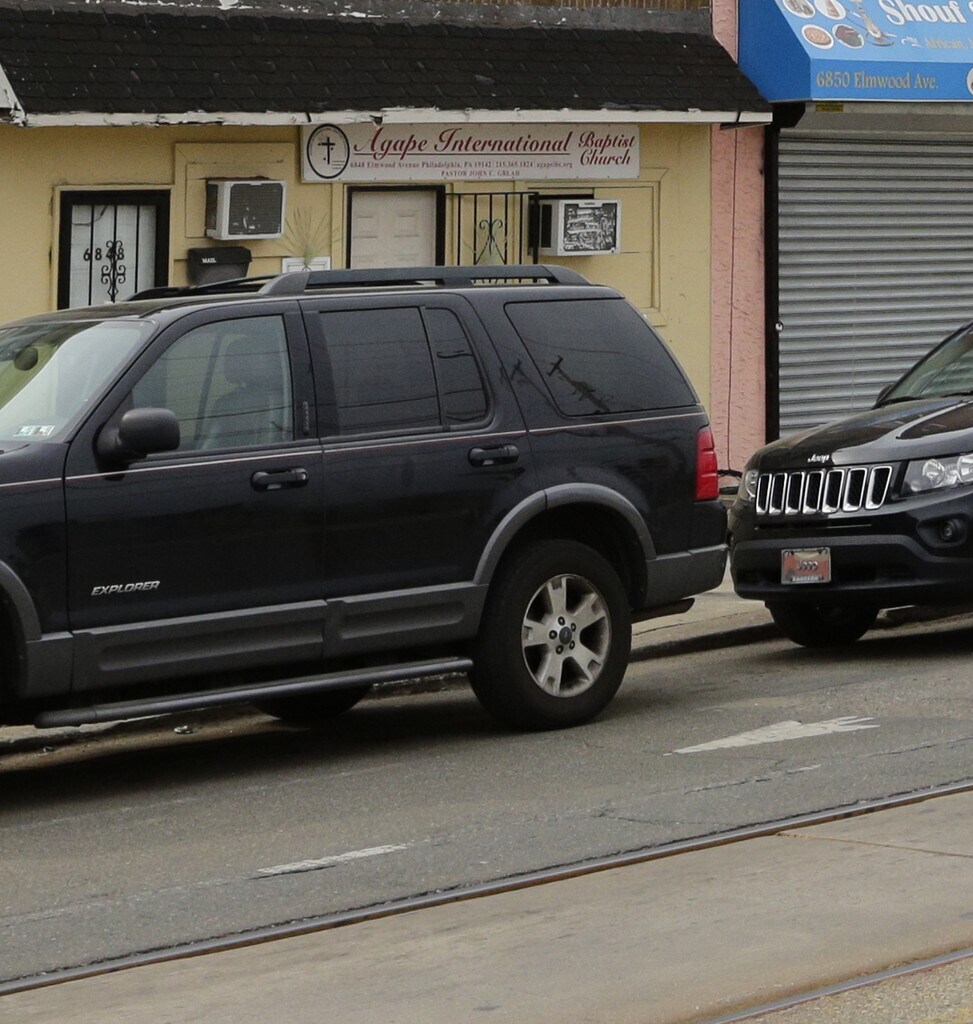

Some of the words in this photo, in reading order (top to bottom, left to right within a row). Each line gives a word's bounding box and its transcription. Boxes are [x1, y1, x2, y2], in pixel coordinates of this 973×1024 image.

[816, 72, 850, 88] 6850
[854, 72, 910, 89] Elmwood
[914, 73, 939, 89] Ave.
[353, 127, 428, 160] Agape
[434, 128, 573, 152] International
[579, 131, 635, 154] Baptist
[580, 148, 631, 166] Church
[91, 580, 160, 596] EXPLORER
